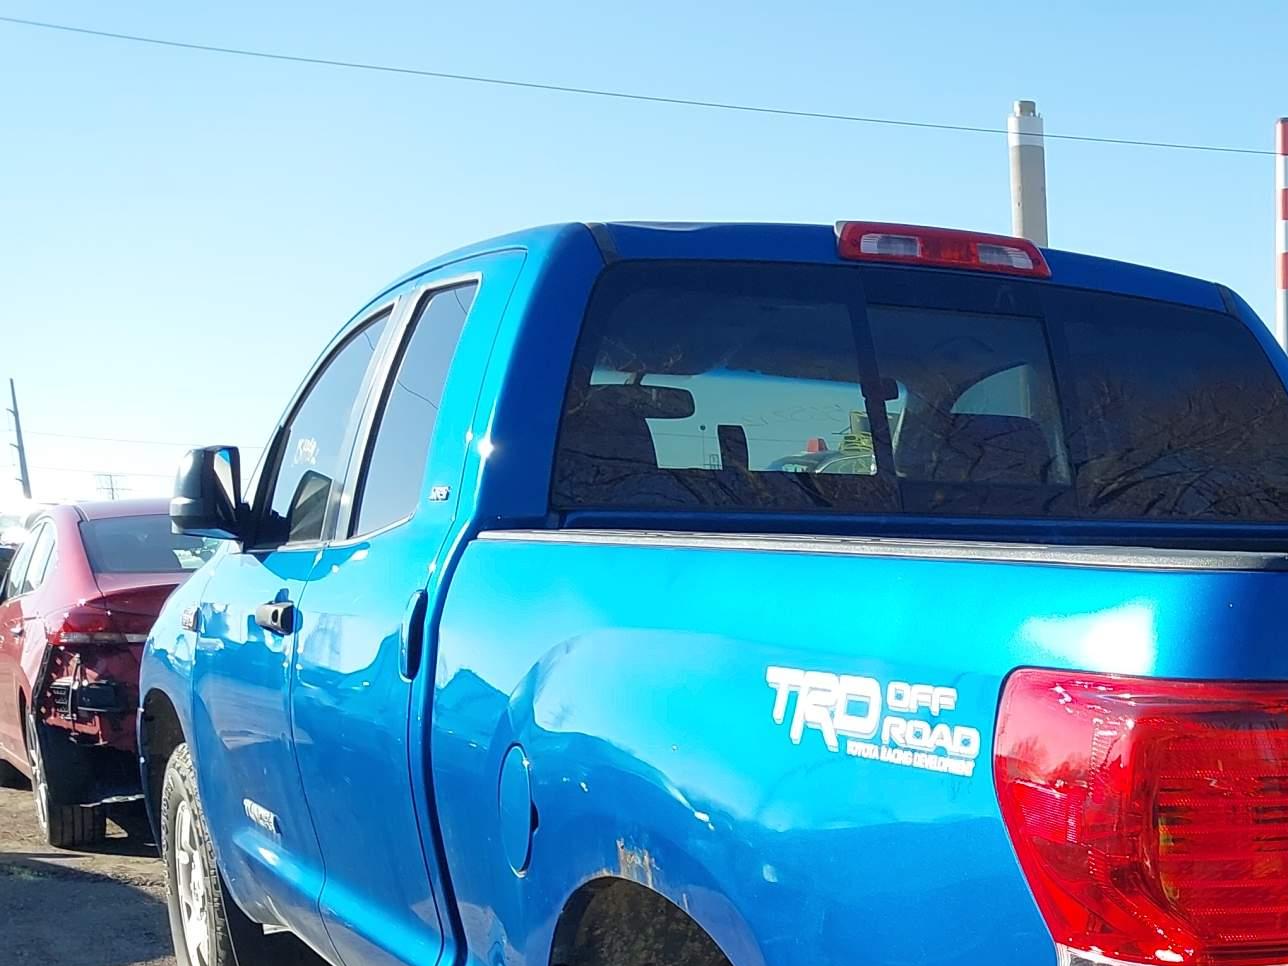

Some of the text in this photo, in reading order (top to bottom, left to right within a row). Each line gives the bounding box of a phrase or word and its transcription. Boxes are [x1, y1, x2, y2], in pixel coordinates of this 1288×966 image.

[766, 665, 882, 752] TRD
[887, 680, 958, 716] OFF
[881, 715, 980, 760] ROAD
